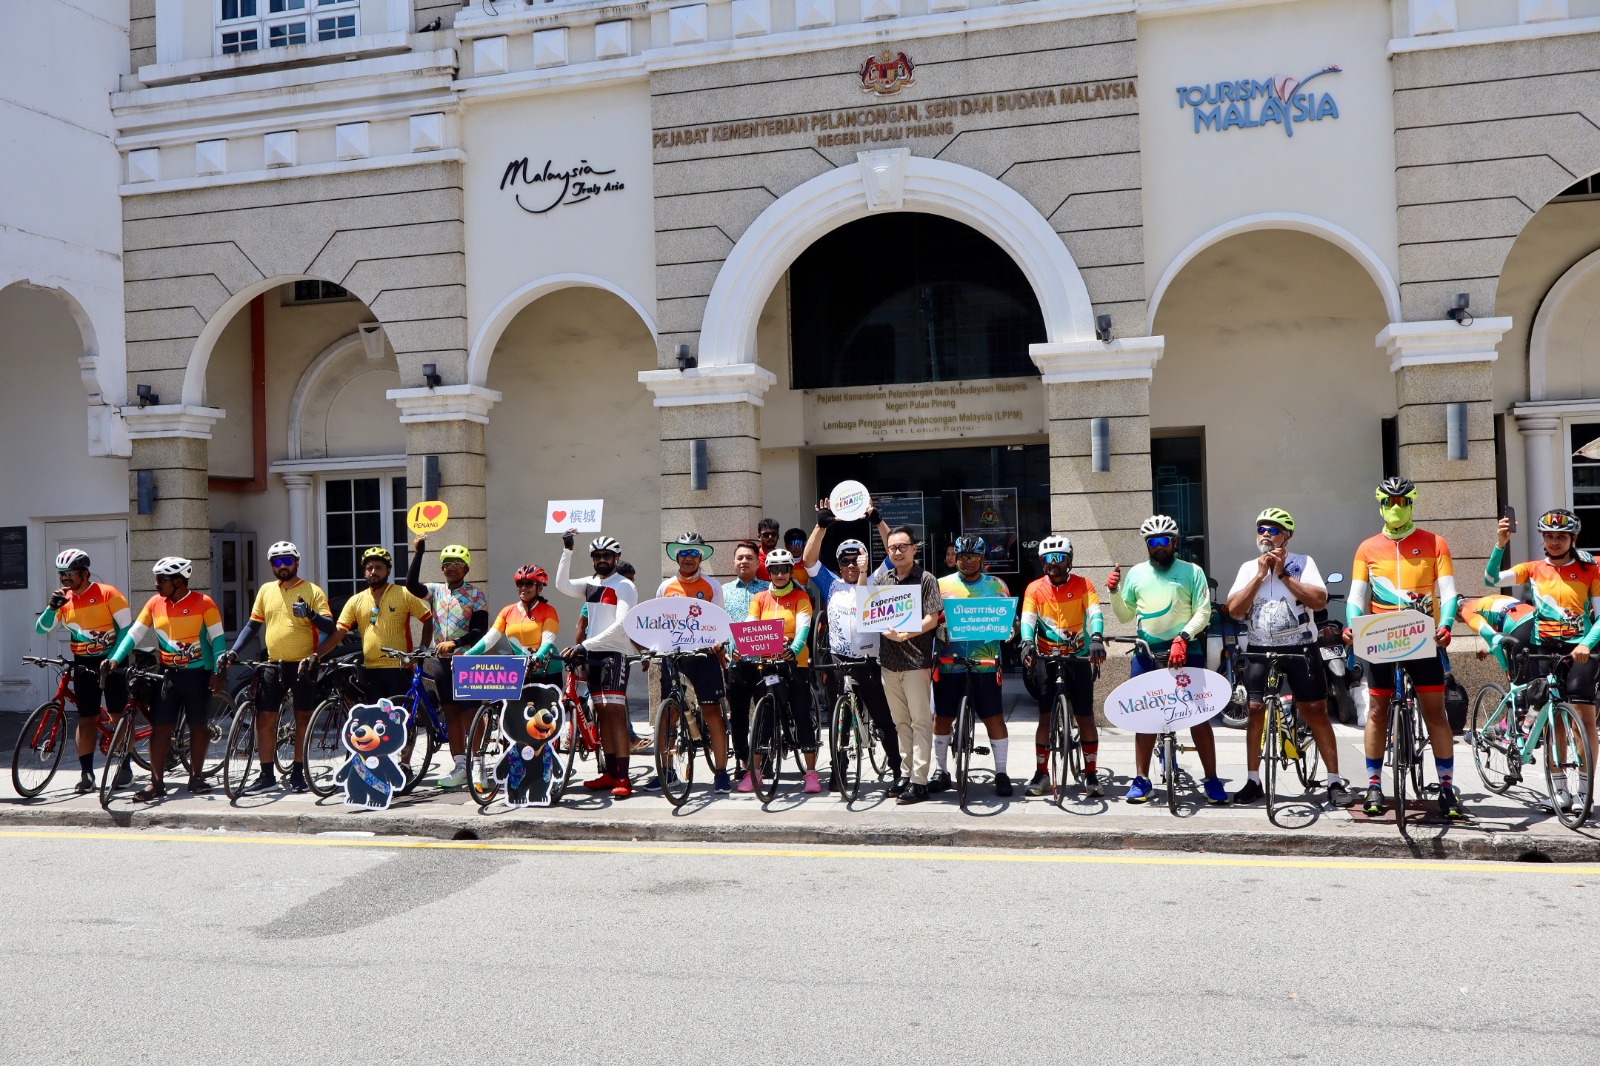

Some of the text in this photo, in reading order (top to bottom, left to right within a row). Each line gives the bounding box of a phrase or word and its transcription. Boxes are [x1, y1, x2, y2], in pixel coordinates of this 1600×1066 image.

[1176, 77, 1273, 108] TOURISM
[652, 81, 1137, 148] PEJABAT KEMENTERIAN PELANCONGAN, SENI DAN BUDAYA MALAYSIA
[1193, 88, 1339, 137] MALAYSIA
[817, 121, 954, 148] NEGERI PULAU PINANG
[500, 157, 616, 213] Malaysia
[572, 181, 624, 197] Truly Asia
[817, 382, 1027, 404] Pejabat Kementerian Pelancongan Dan Kebudayaan Malaysia
[885, 399, 955, 412] Negeri Pulau Pinang
[823, 410, 1022, 430] Lembaga Penggalakan Pelancongan Malaysia (LPPM)
[415, 506, 421, 522] I
[870, 592, 912, 608] Experience
[862, 599, 913, 621] PENANG
[636, 616, 699, 632] Malaysia
[742, 624, 772, 633] PENANG
[1387, 624, 1425, 641] PULAU
[738, 633, 779, 643] WELCOMES
[1367, 637, 1410, 655] PINANG
[458, 671, 518, 684] PINANG
[1118, 685, 1213, 714] Malaysia 2026
[1195, 705, 1215, 715] Asia
